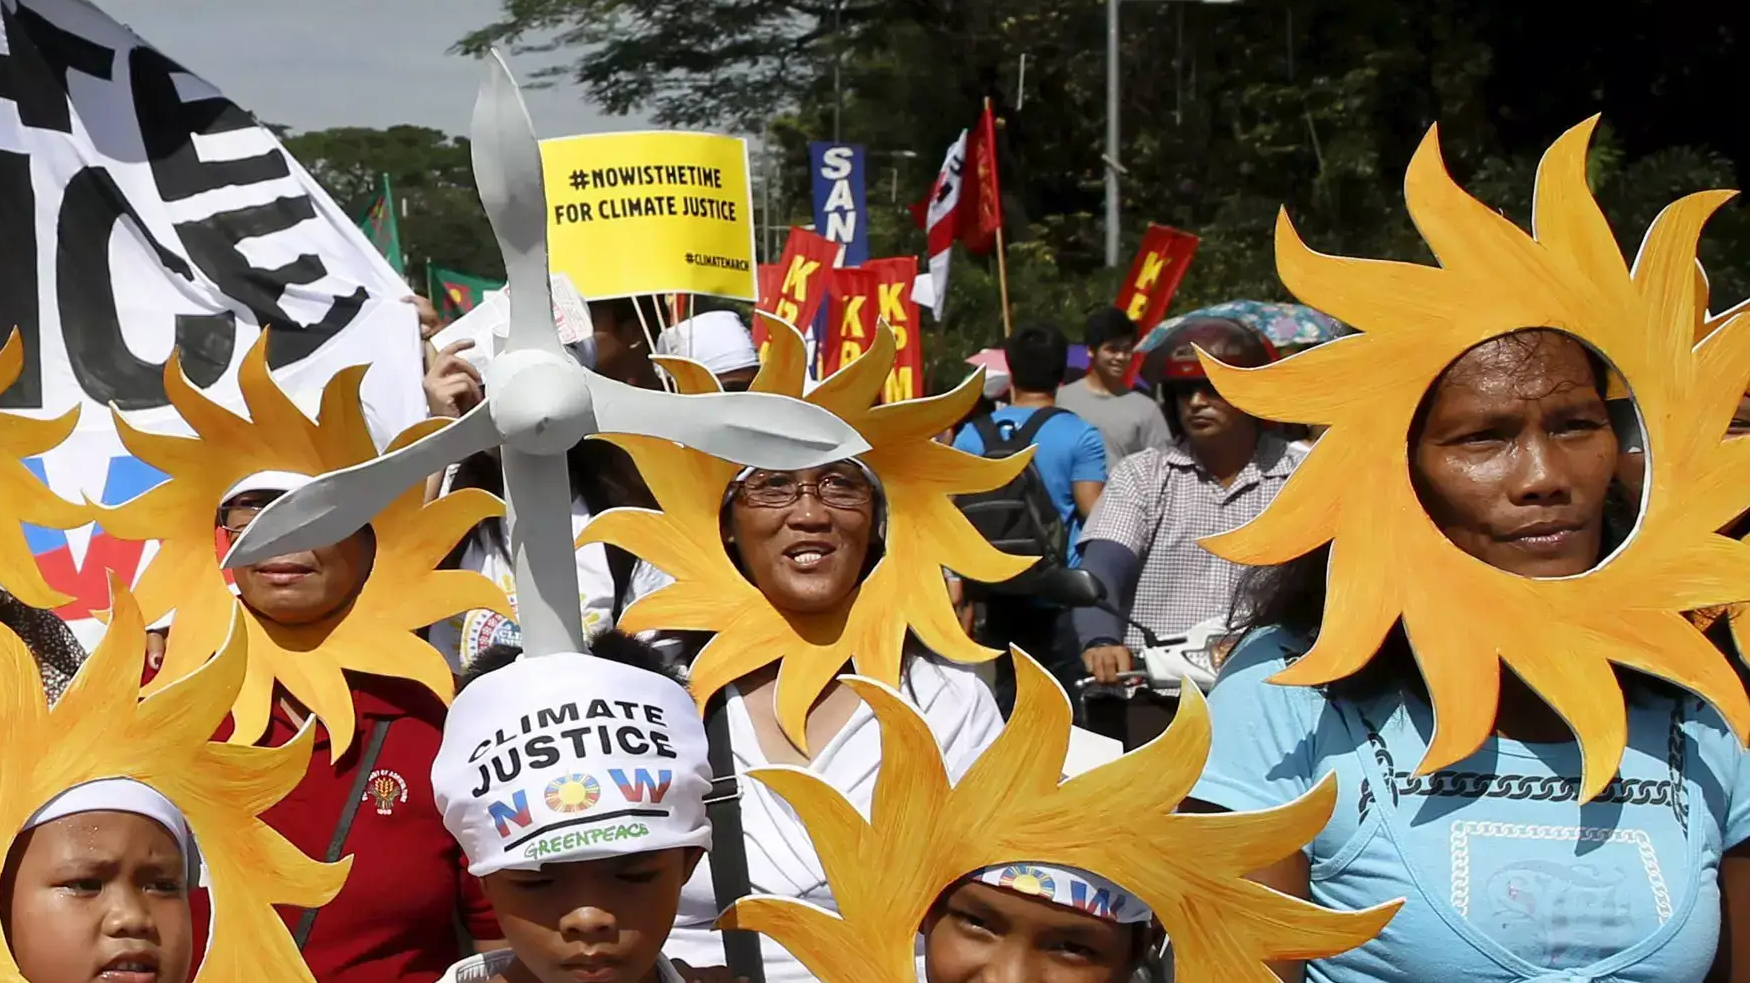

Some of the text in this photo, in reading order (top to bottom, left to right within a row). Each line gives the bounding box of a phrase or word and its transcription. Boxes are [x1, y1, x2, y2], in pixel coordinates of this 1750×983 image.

[569, 166, 722, 190] #NOWISTHETIME
[554, 197, 736, 225] FOR CLIMATE JUSTICE
[685, 253, 750, 272] #CLIMATEMARCH
[468, 699, 667, 763] CLIMATE
[472, 725, 677, 797] JUSTICE
[488, 768, 672, 838] NOW
[524, 823, 649, 860] GREENPEACE
